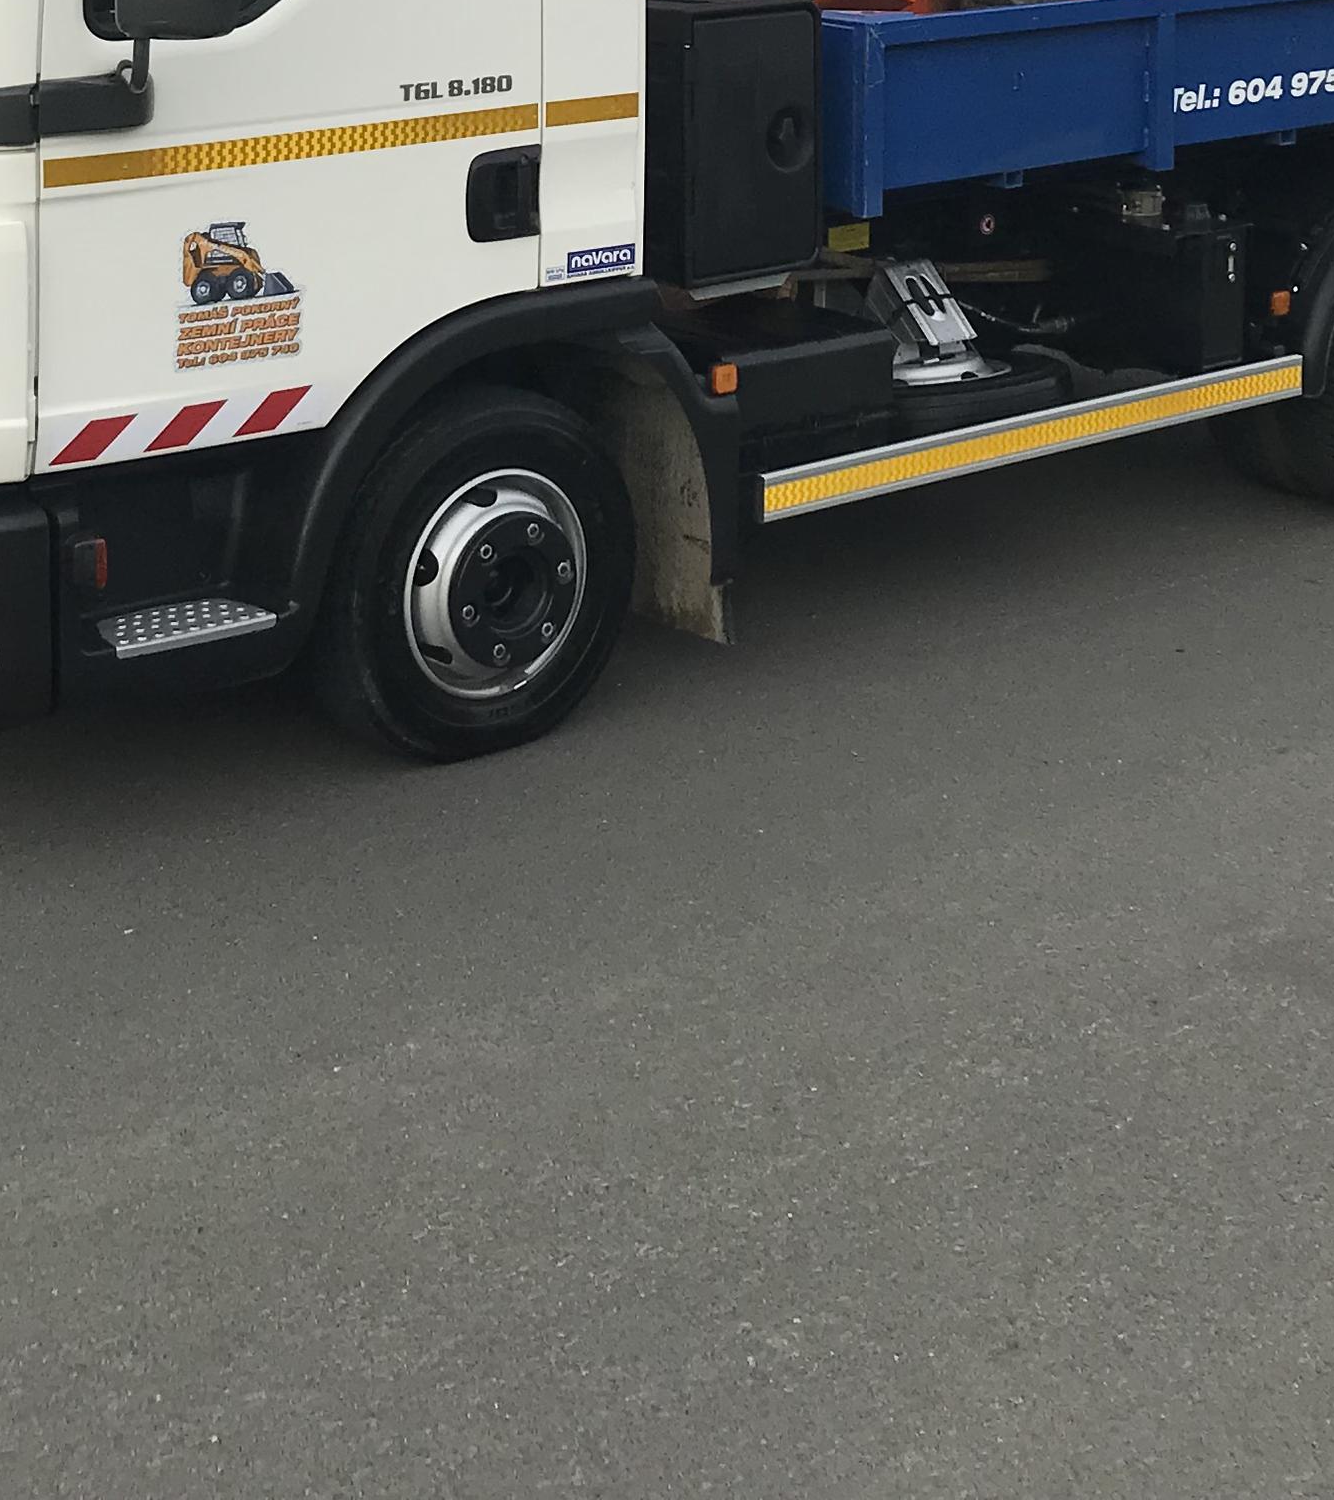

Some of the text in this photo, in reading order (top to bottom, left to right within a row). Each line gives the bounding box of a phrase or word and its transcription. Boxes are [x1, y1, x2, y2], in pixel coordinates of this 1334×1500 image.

[448, 74, 513, 97] 8.180
[1228, 75, 1283, 105] 604
[178, 312, 300, 341] ZEMNÍ PRÁCE
[177, 327, 300, 356] KONTEJNERY
